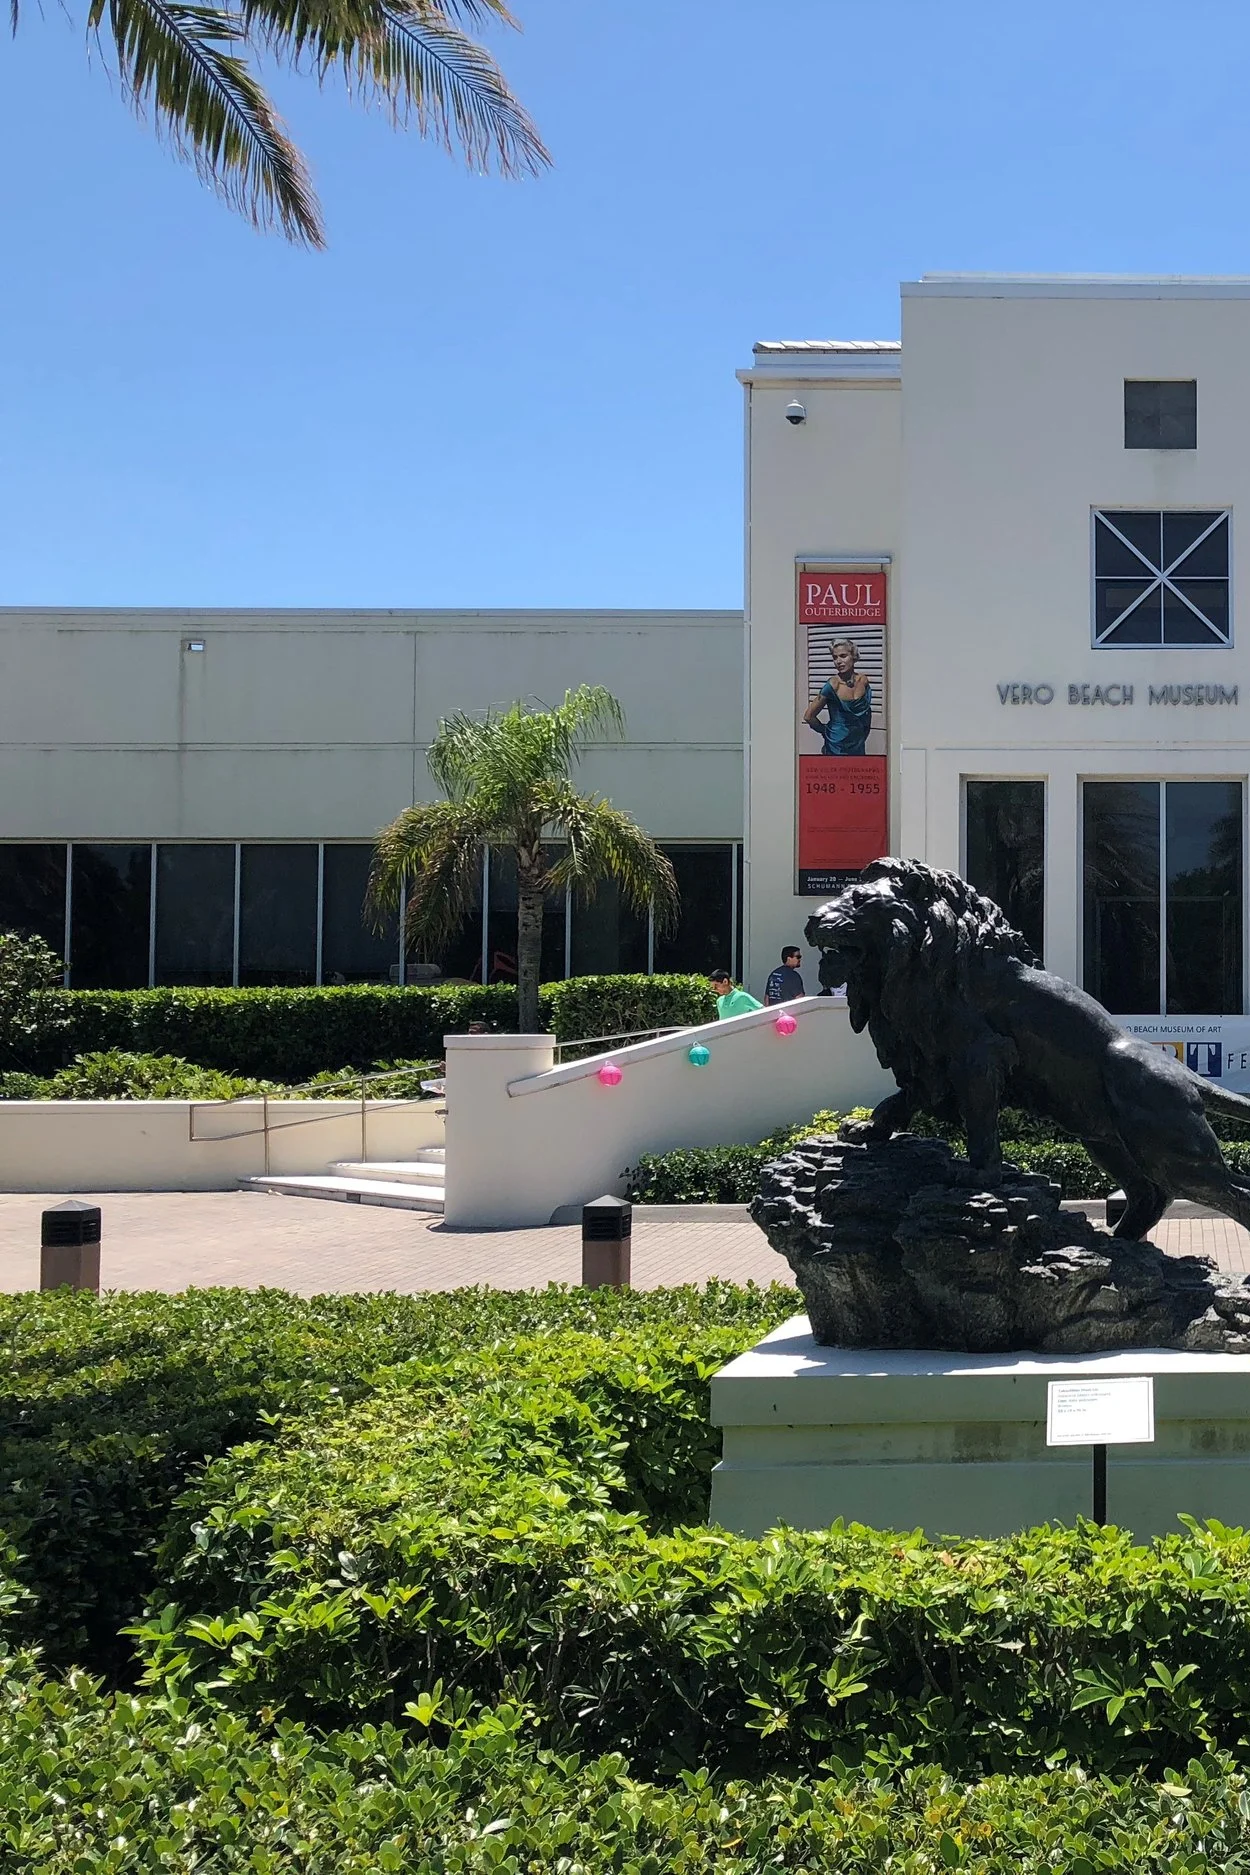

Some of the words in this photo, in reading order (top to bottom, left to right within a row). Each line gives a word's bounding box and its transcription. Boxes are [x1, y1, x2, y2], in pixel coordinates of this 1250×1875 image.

[806, 583, 881, 606] PAUL
[804, 607, 881, 617] OUTERBRIDGE
[996, 684, 1054, 706] VERO
[1067, 684, 1134, 706] BEACH
[1148, 684, 1239, 706] MUSEUM
[806, 783, 836, 794] 1948
[850, 783, 880, 794] 1955
